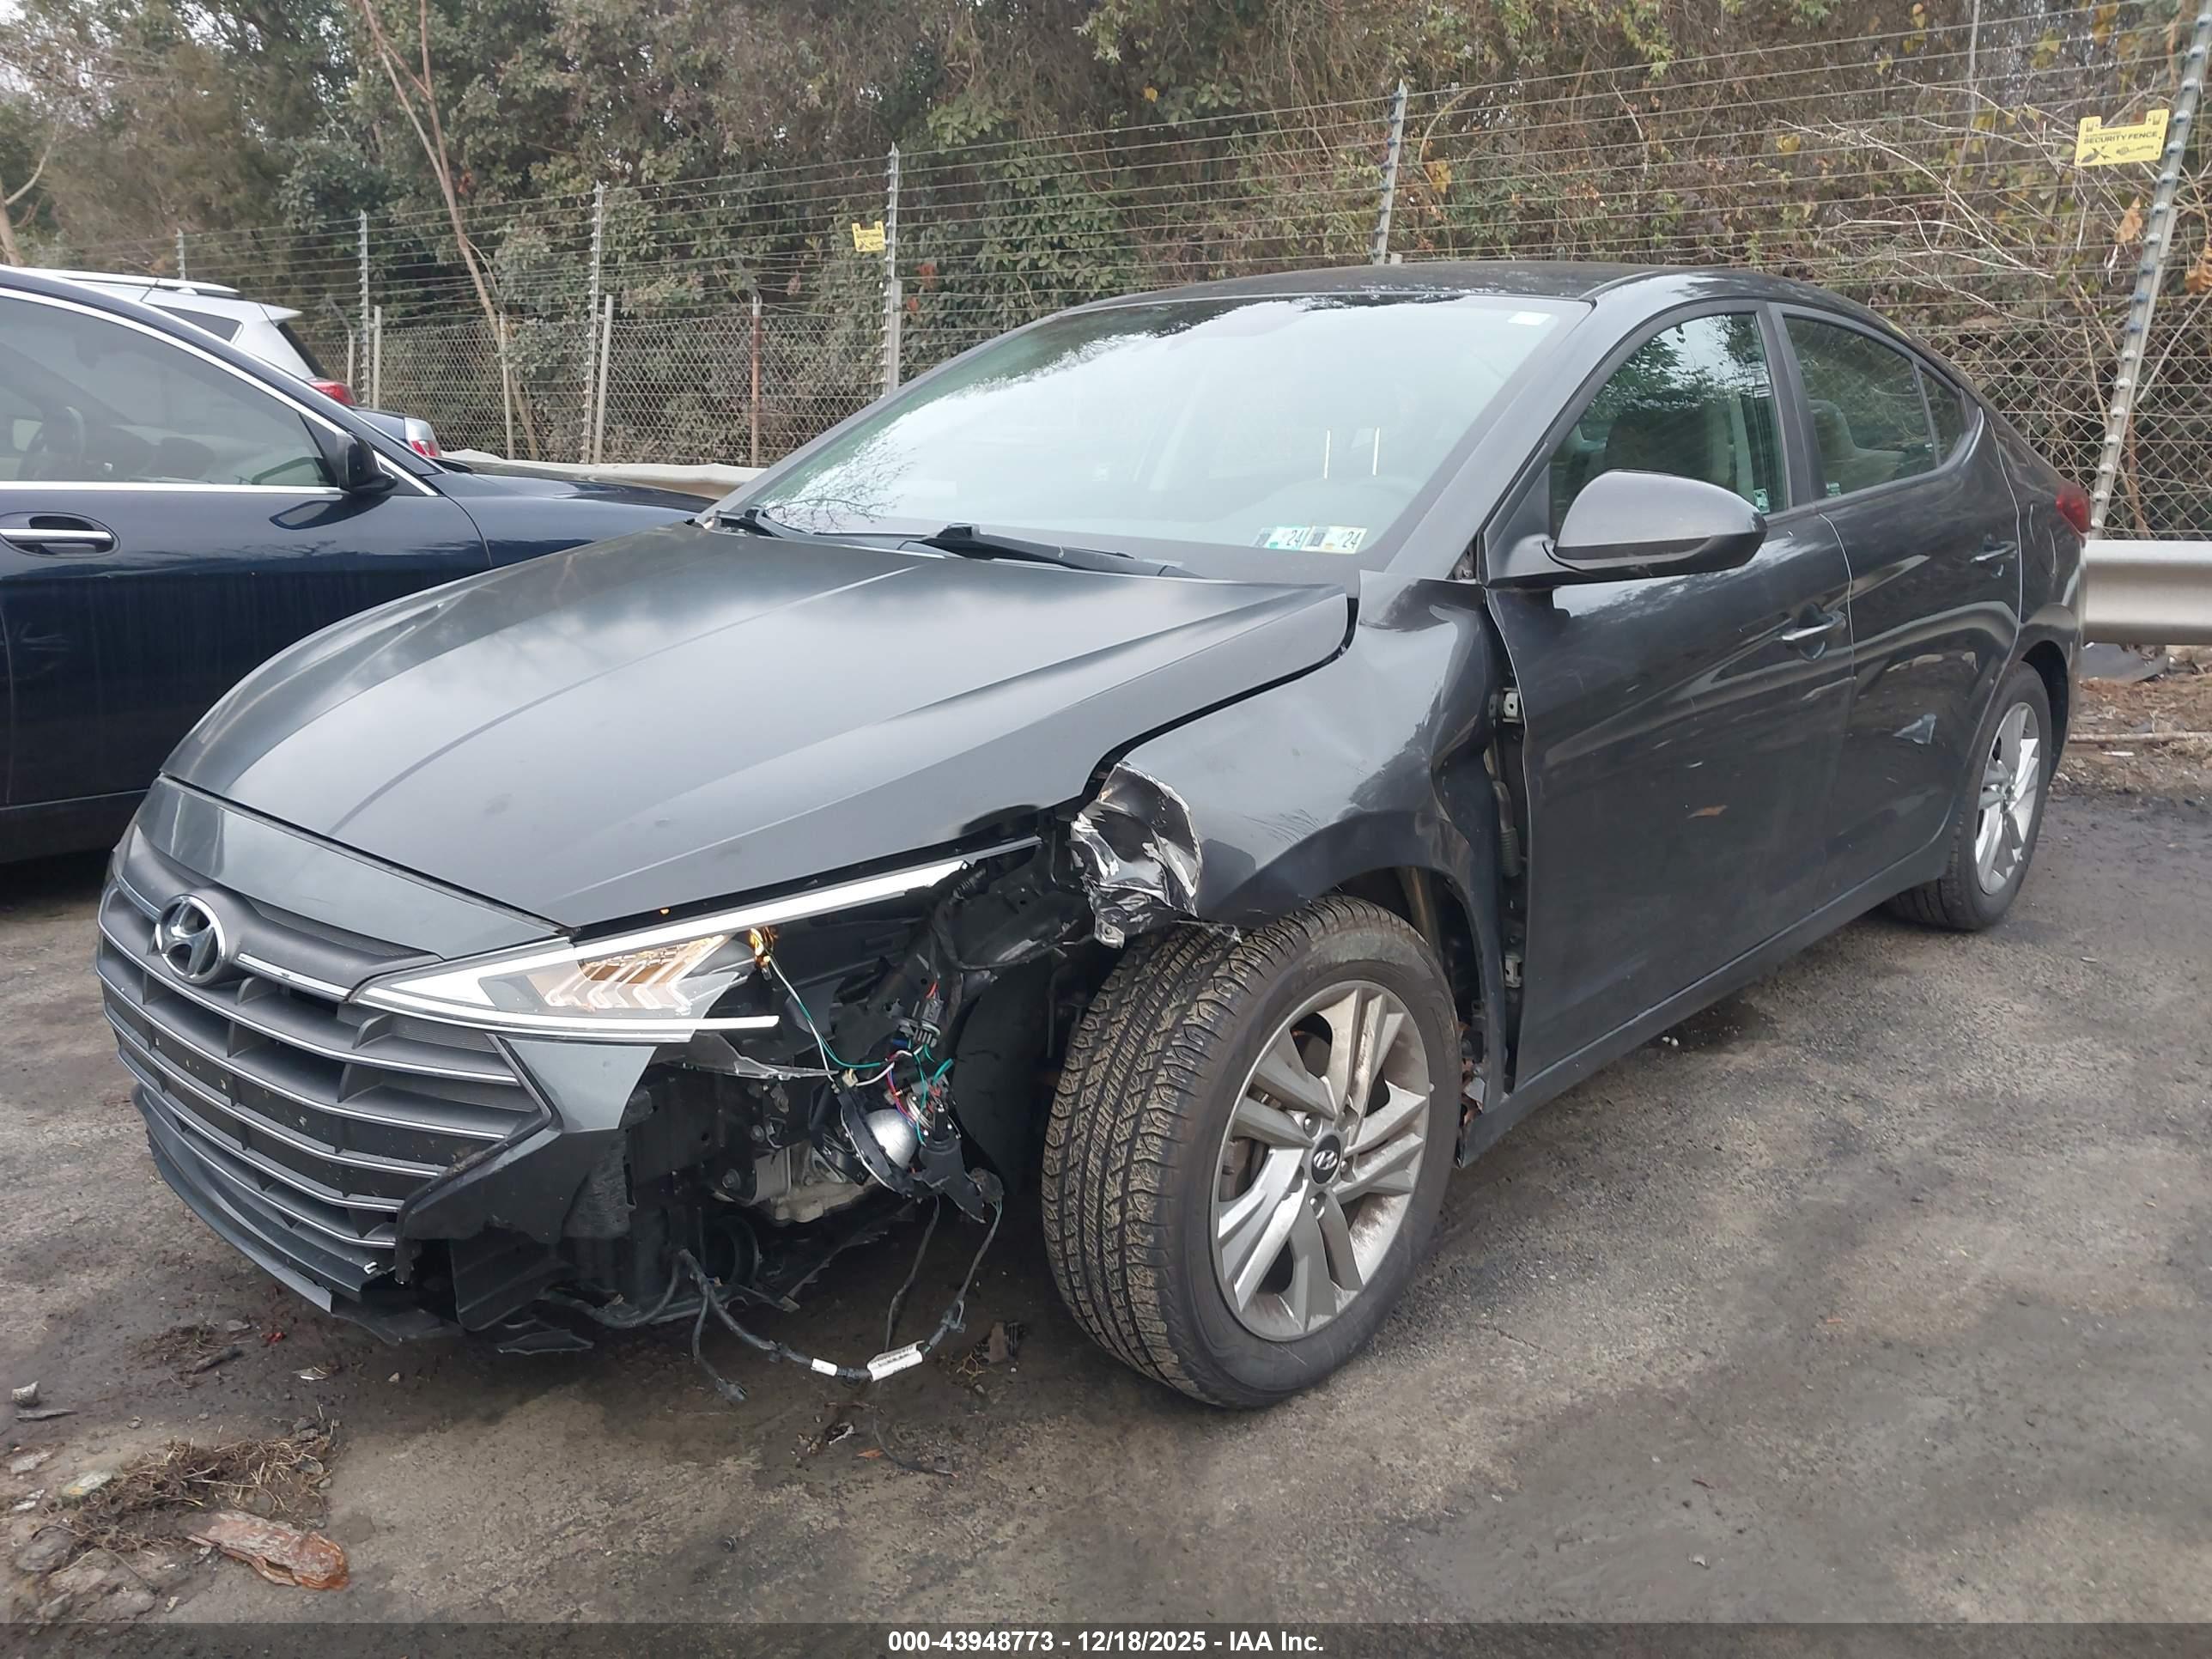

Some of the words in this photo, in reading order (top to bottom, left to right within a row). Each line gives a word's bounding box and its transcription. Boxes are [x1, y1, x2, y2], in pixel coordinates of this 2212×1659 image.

[2084, 134, 2126, 144] SECURITY
[2128, 131, 2158, 141] FENCE
[1286, 529, 1304, 546] 24
[1342, 531, 1361, 549] 24
